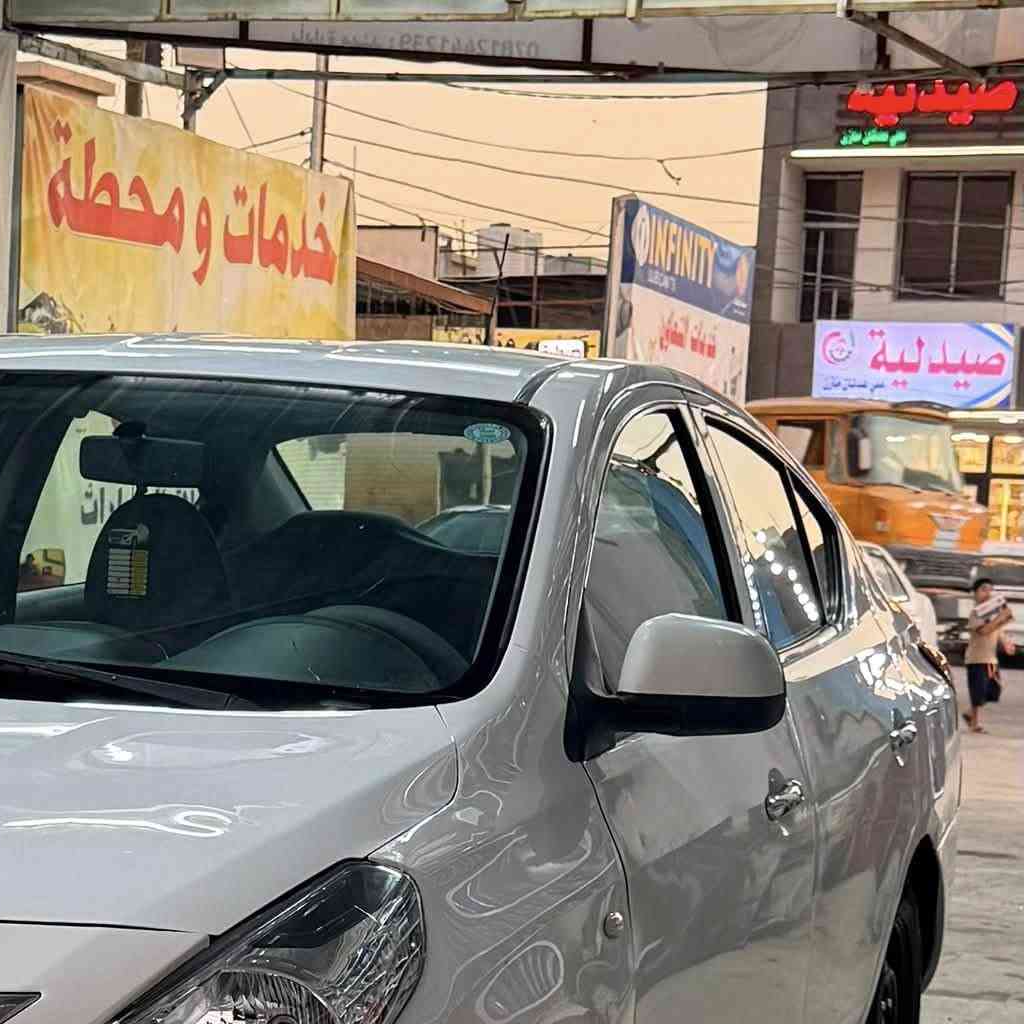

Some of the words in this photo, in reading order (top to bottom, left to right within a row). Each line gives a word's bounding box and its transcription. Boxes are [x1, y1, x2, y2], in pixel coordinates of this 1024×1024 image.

[223, 179, 338, 285] خدمات
[648, 214, 719, 288] INFINITY
[868, 329, 1006, 390] صيدلية
